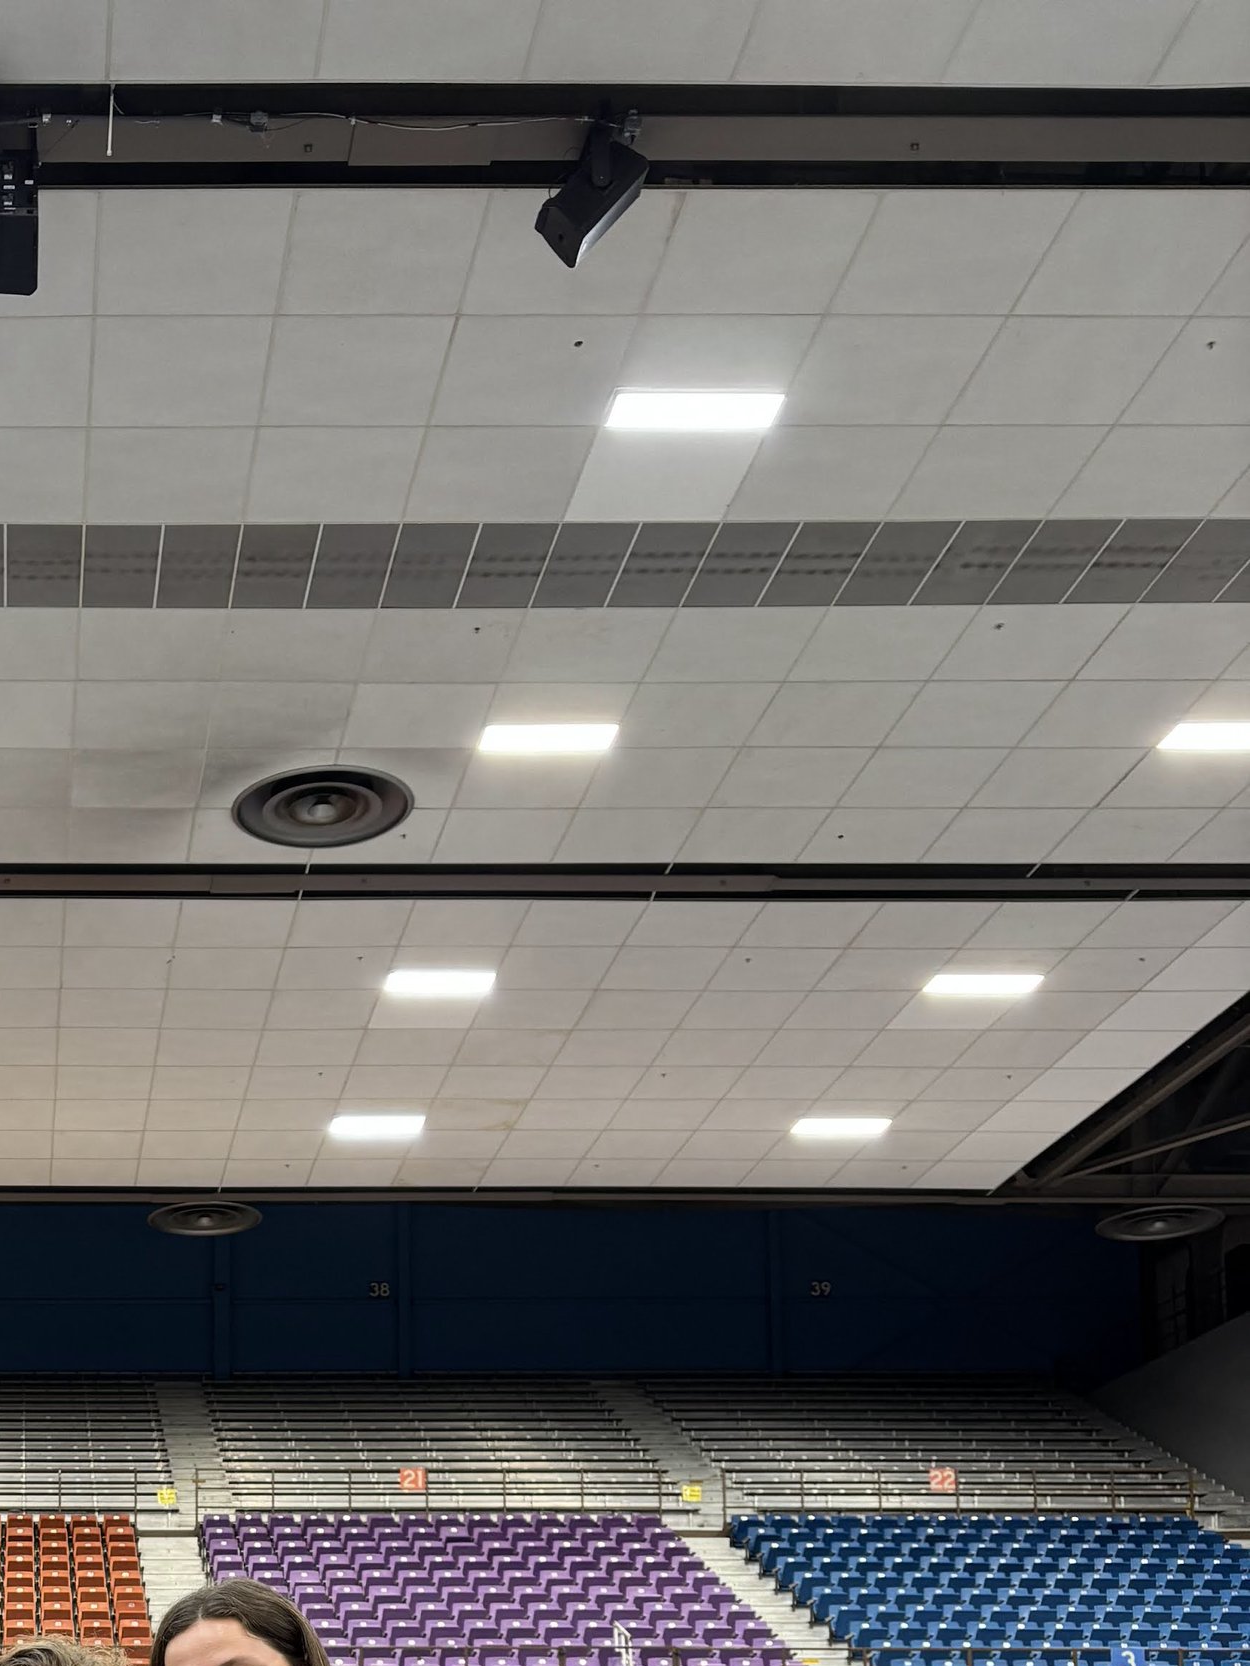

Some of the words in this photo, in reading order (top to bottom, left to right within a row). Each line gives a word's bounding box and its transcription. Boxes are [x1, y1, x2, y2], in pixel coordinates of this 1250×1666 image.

[370, 1282, 390, 1297] 38
[811, 1282, 831, 1296] 39
[403, 1470, 423, 1488] 21
[930, 1470, 956, 1487] 22
